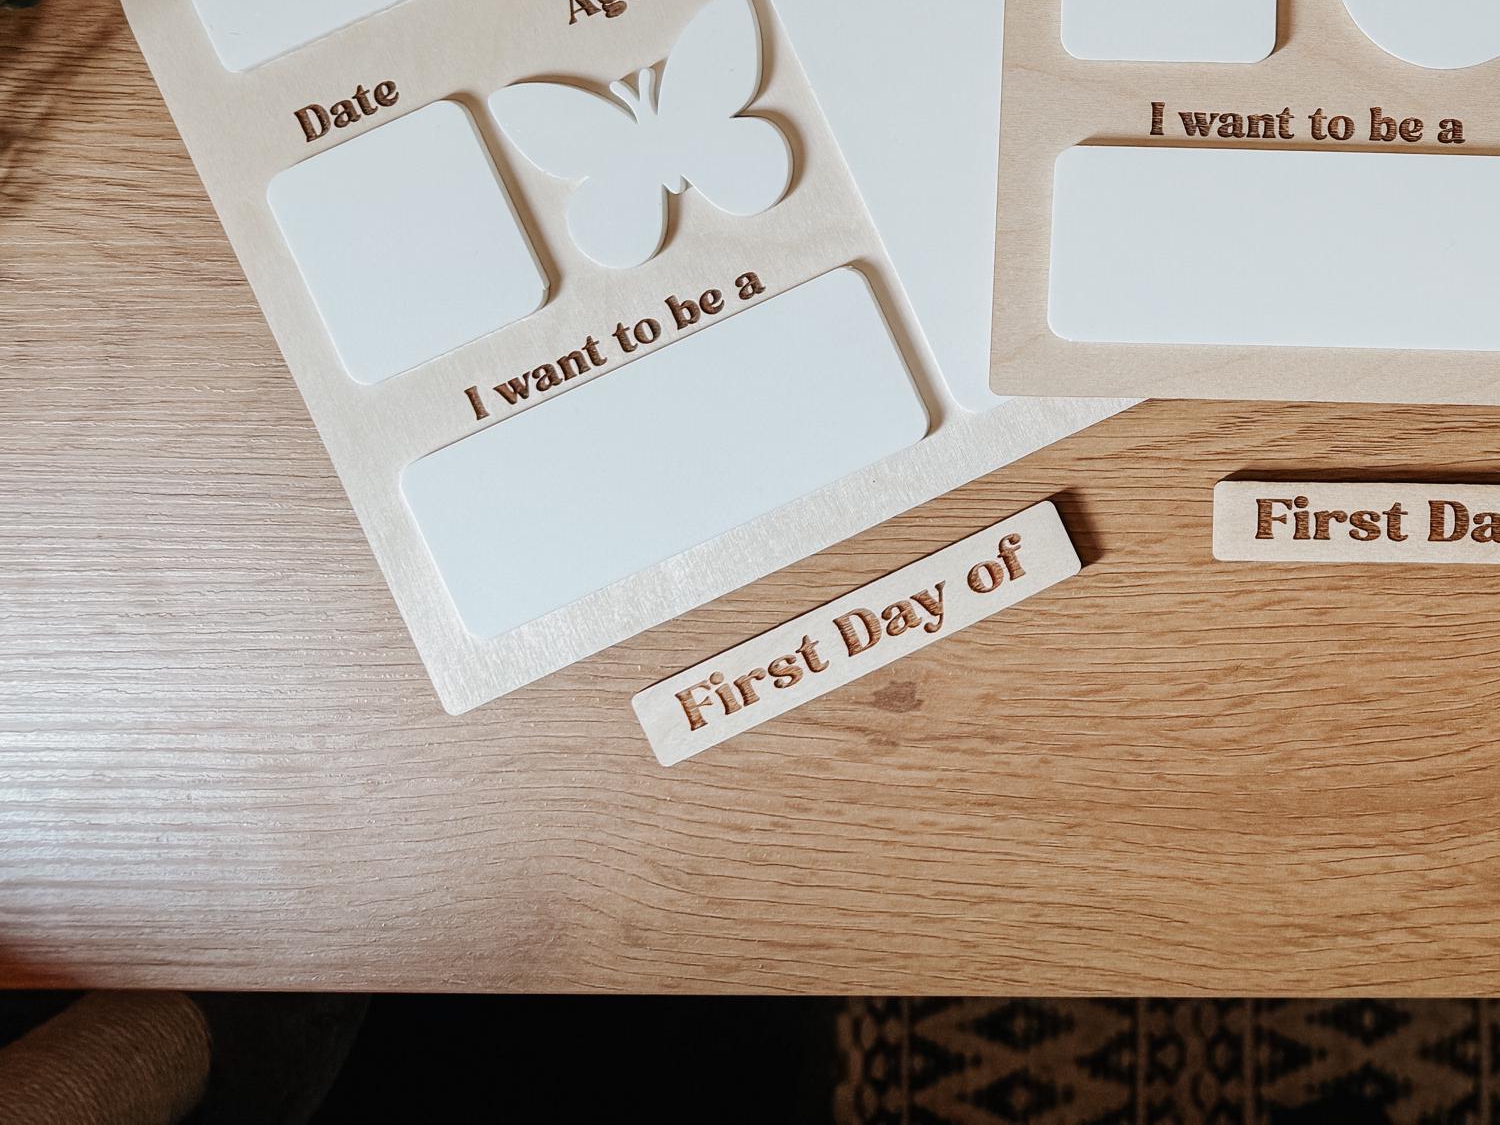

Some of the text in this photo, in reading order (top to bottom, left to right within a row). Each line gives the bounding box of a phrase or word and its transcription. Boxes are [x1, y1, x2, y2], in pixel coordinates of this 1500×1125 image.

[293, 79, 401, 144] Date
[1149, 101, 1466, 144] I want to be a
[463, 271, 767, 421] I want to be a
[1254, 495, 1410, 543] First
[673, 532, 1026, 732] First Day of
